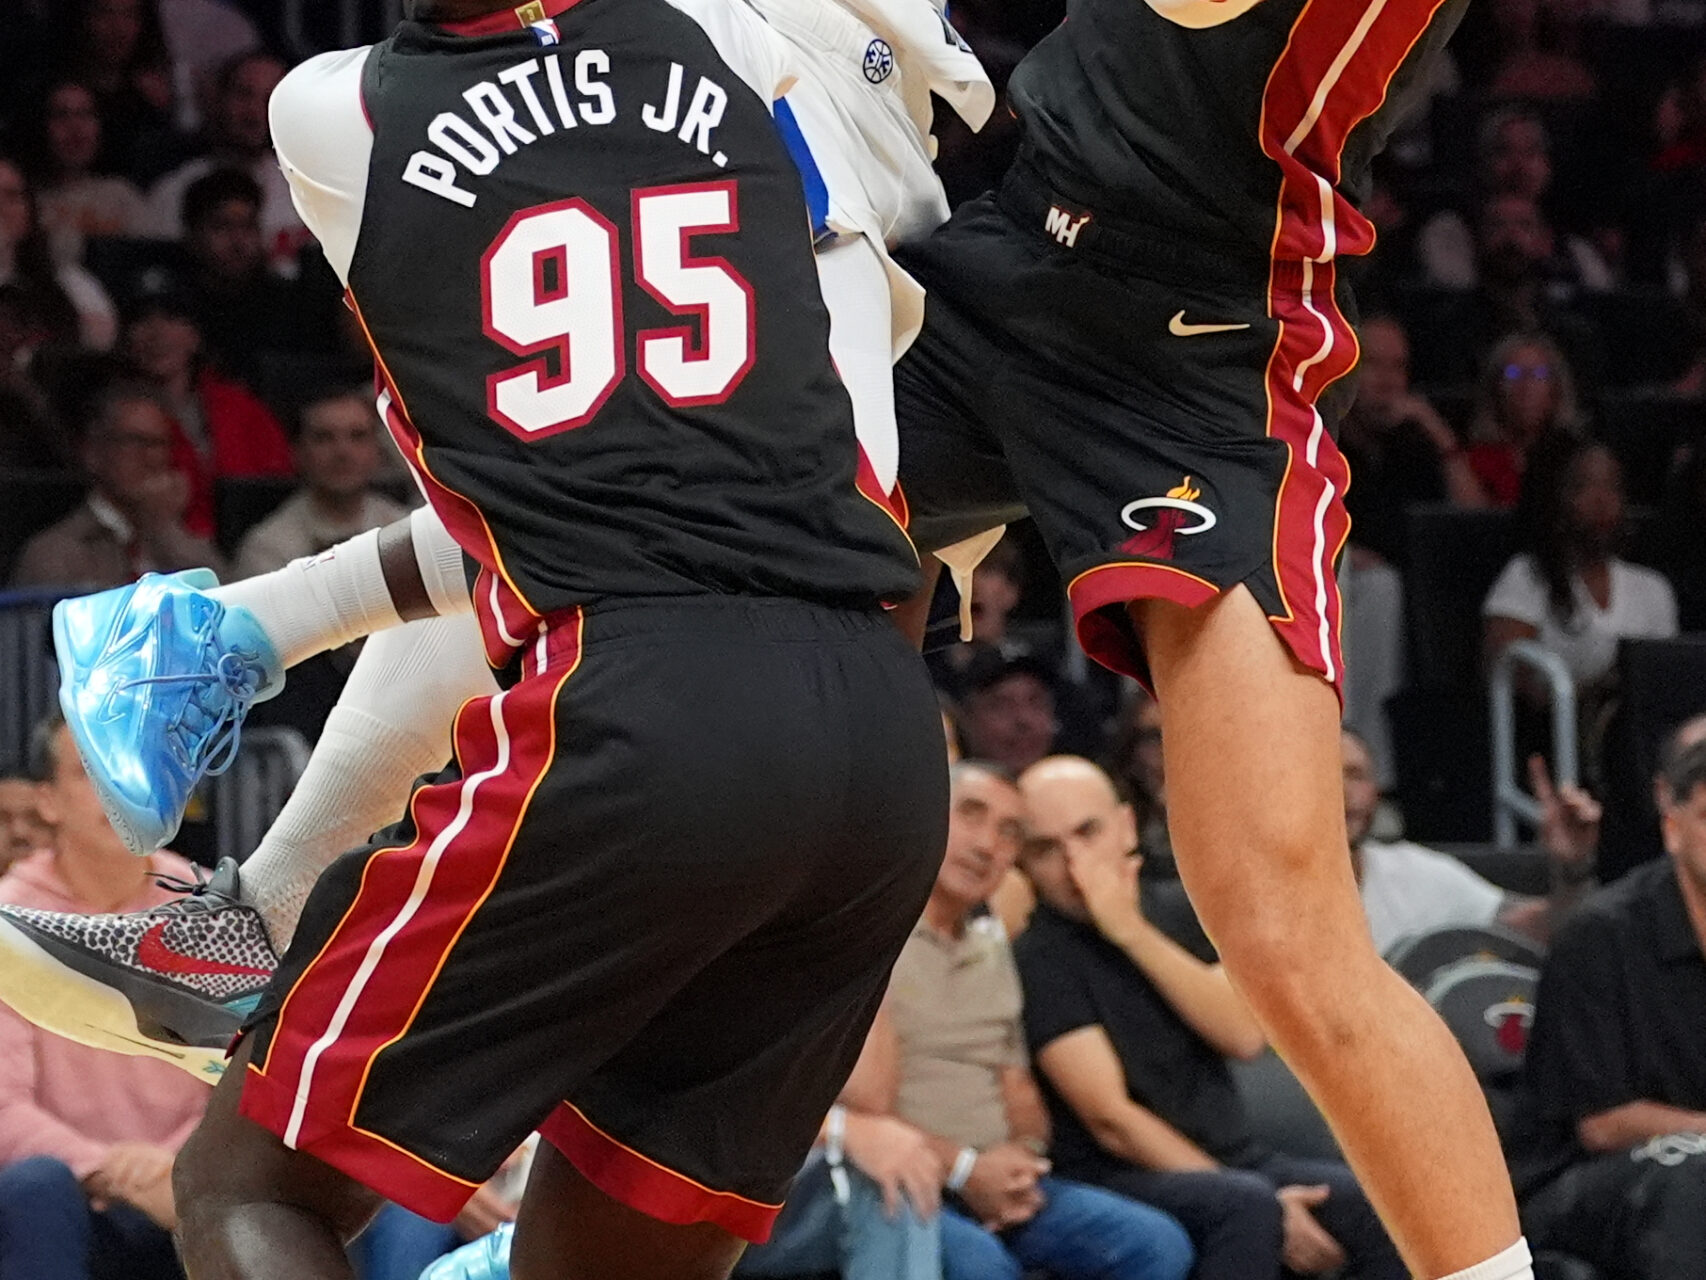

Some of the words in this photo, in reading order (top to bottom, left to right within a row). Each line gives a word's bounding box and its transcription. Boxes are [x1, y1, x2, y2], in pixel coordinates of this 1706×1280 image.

[402, 49, 616, 208] PORTIS
[641, 62, 728, 168] JR.
[480, 179, 756, 443] 95
